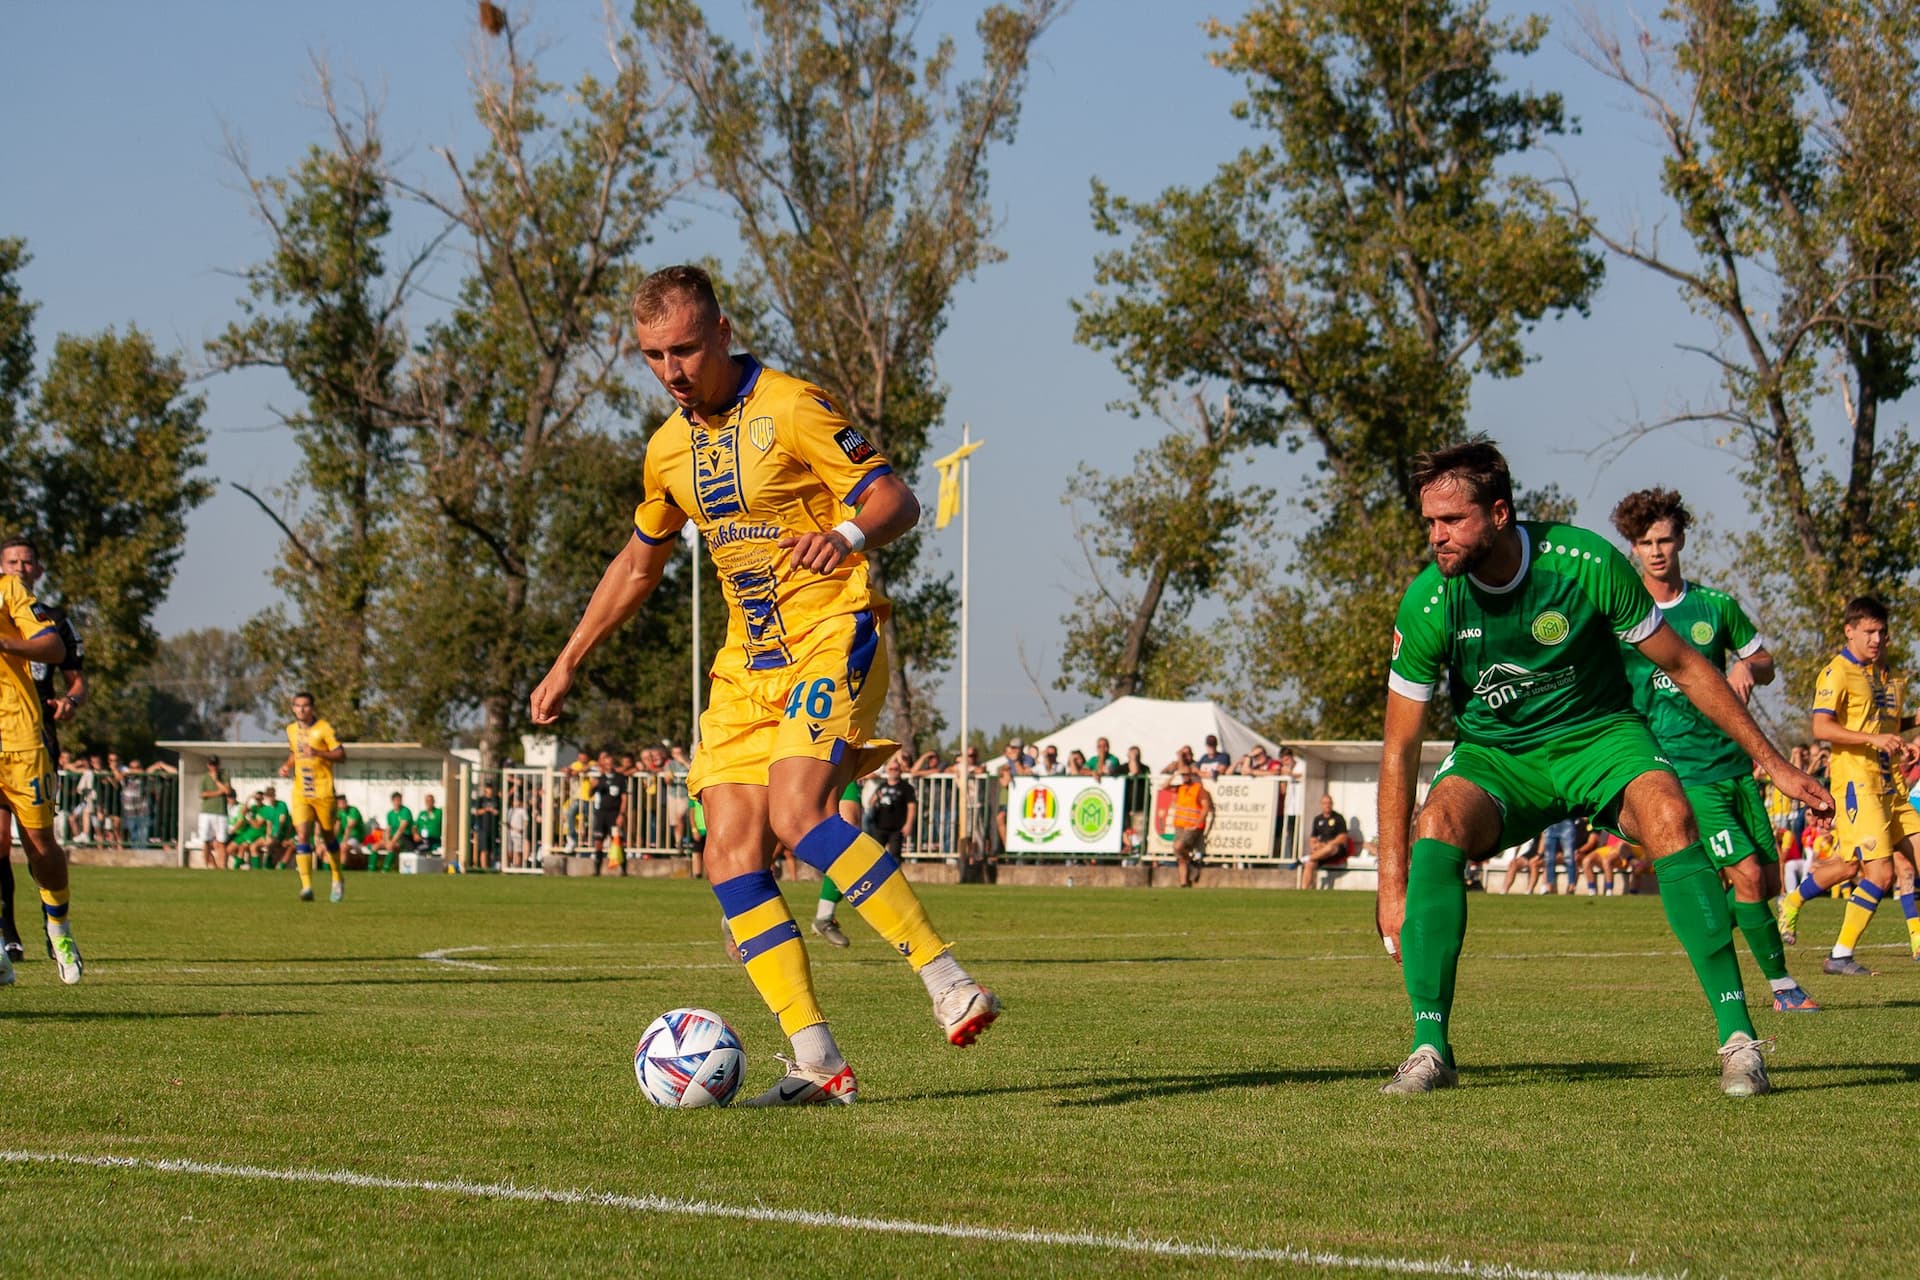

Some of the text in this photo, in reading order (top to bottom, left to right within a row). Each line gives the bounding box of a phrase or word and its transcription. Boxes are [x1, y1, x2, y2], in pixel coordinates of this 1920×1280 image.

[1653, 674, 1676, 690] KO
[784, 677, 836, 719] 46
[1217, 785, 1249, 797] OBEC
[1709, 829, 1734, 858] 47
[1415, 1011, 1442, 1022] JAKO
